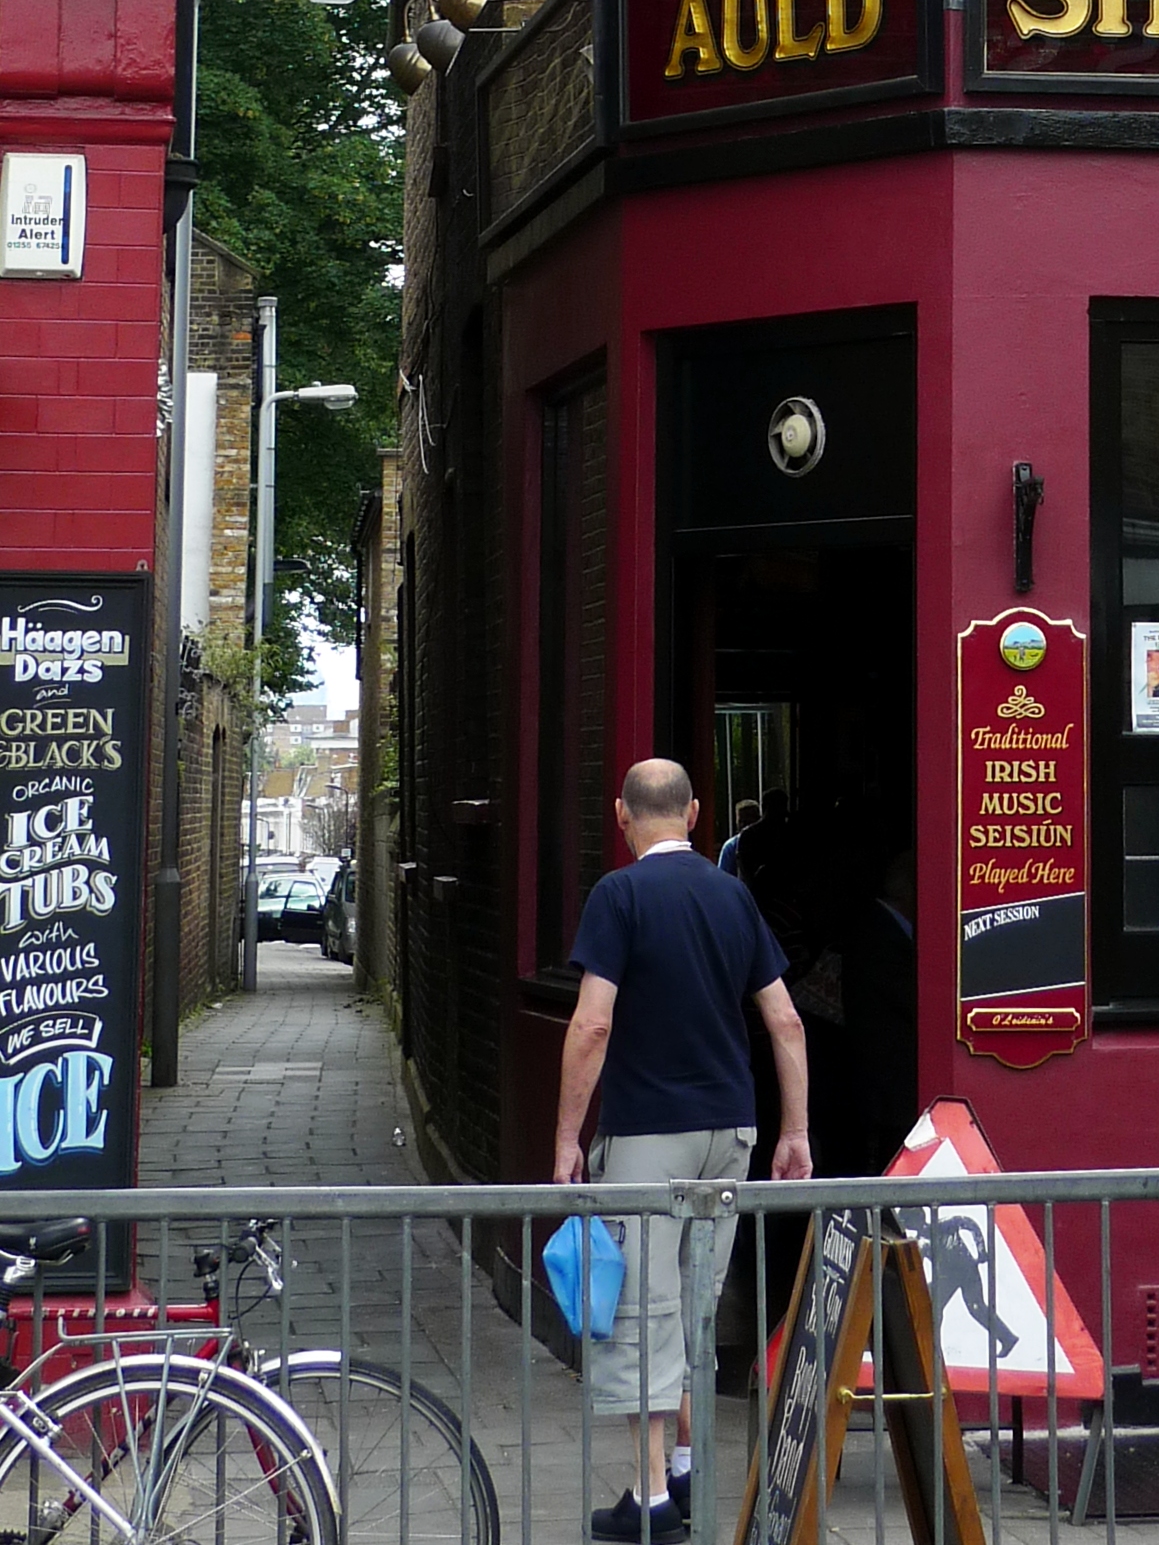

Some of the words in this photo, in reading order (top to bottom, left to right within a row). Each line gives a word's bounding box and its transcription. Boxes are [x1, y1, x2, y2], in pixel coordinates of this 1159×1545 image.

[11, 214, 65, 226] Intruder
[18, 228, 56, 240] Alert
[1, 617, 123, 660] Häagen
[14, 654, 103, 682] Dazs
[35, 684, 69, 700] and
[0, 708, 115, 736] GREEN
[971, 723, 1074, 749] Traditional
[985, 760, 1056, 782] IRISH
[12, 775, 94, 801] ORGANIC
[979, 792, 1062, 815] MUSIC
[5, 796, 94, 850] ICE
[969, 819, 1072, 847] SEISIÚN
[0, 833, 111, 878] CREAM
[969, 858, 1033, 893] Played
[1031, 858, 1075, 884] Here
[0, 864, 118, 934] TUBS
[18, 921, 79, 948] with
[963, 913, 993, 941] NEXT
[994, 905, 1040, 927] SESSION
[1, 943, 99, 982] VARIOUS
[0, 975, 108, 1016] FLAVOURS
[8, 1025, 35, 1054] WE
[40, 1018, 89, 1037] SELL
[0, 1051, 113, 1171] ICE
